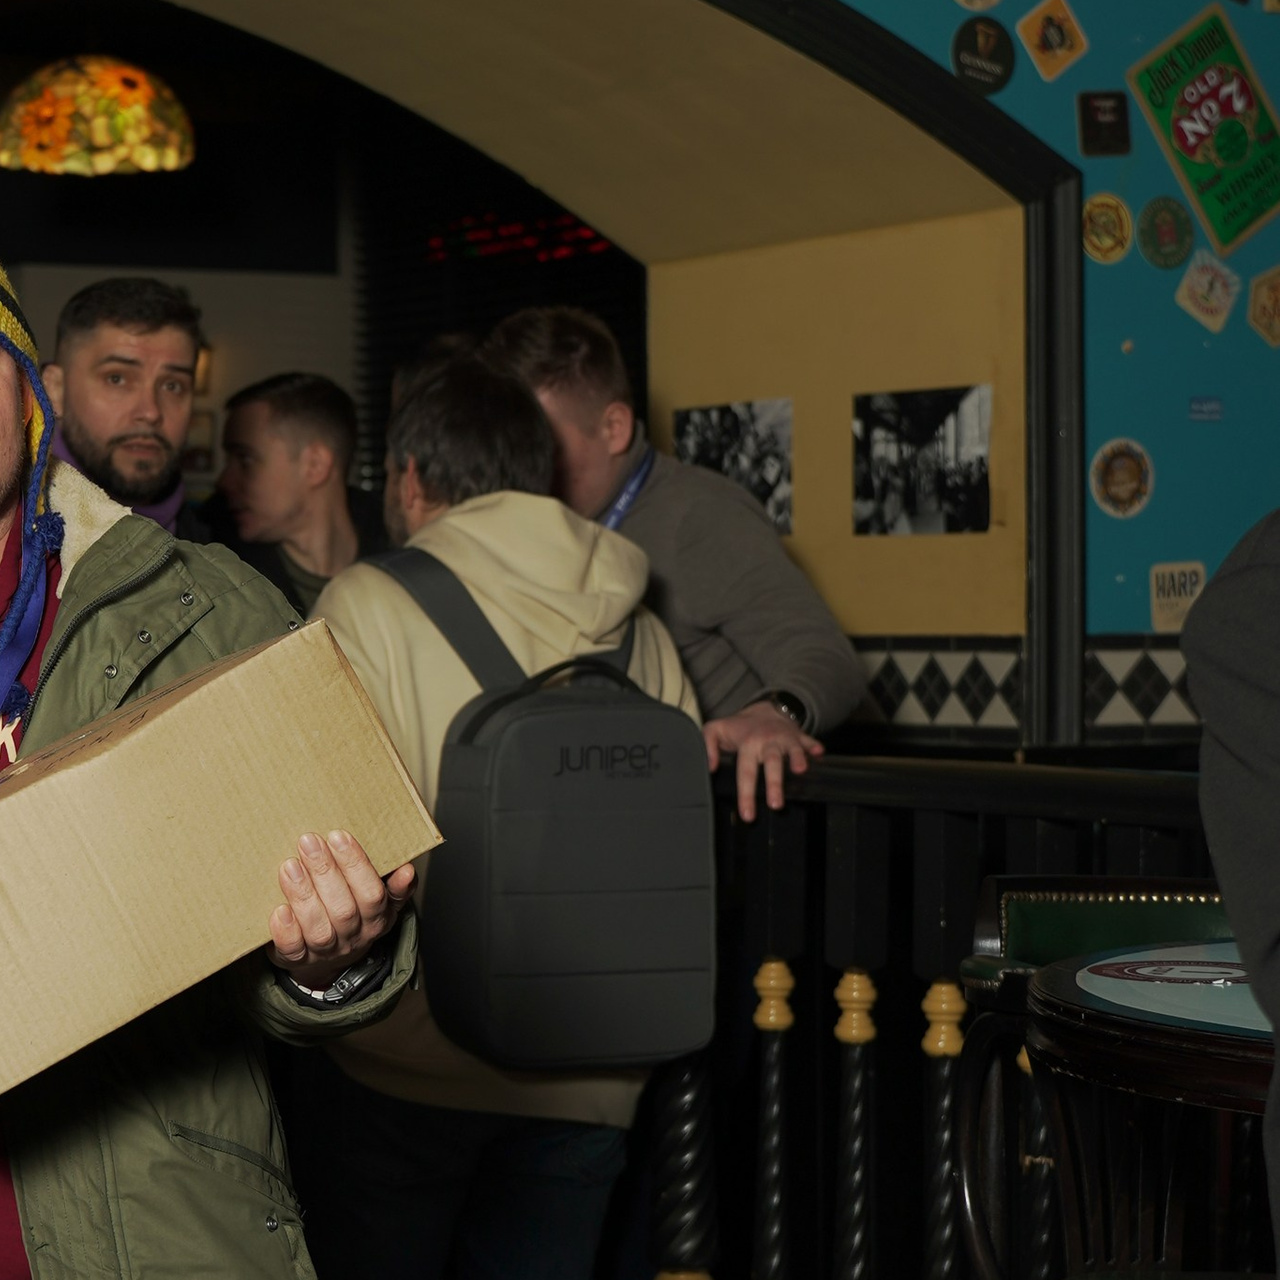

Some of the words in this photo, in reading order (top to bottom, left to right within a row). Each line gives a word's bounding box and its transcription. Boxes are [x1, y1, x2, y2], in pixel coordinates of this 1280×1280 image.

[1183, 68, 1222, 105] OLD
[1218, 73, 1249, 115] 7
[1154, 569, 1200, 600] HARP
